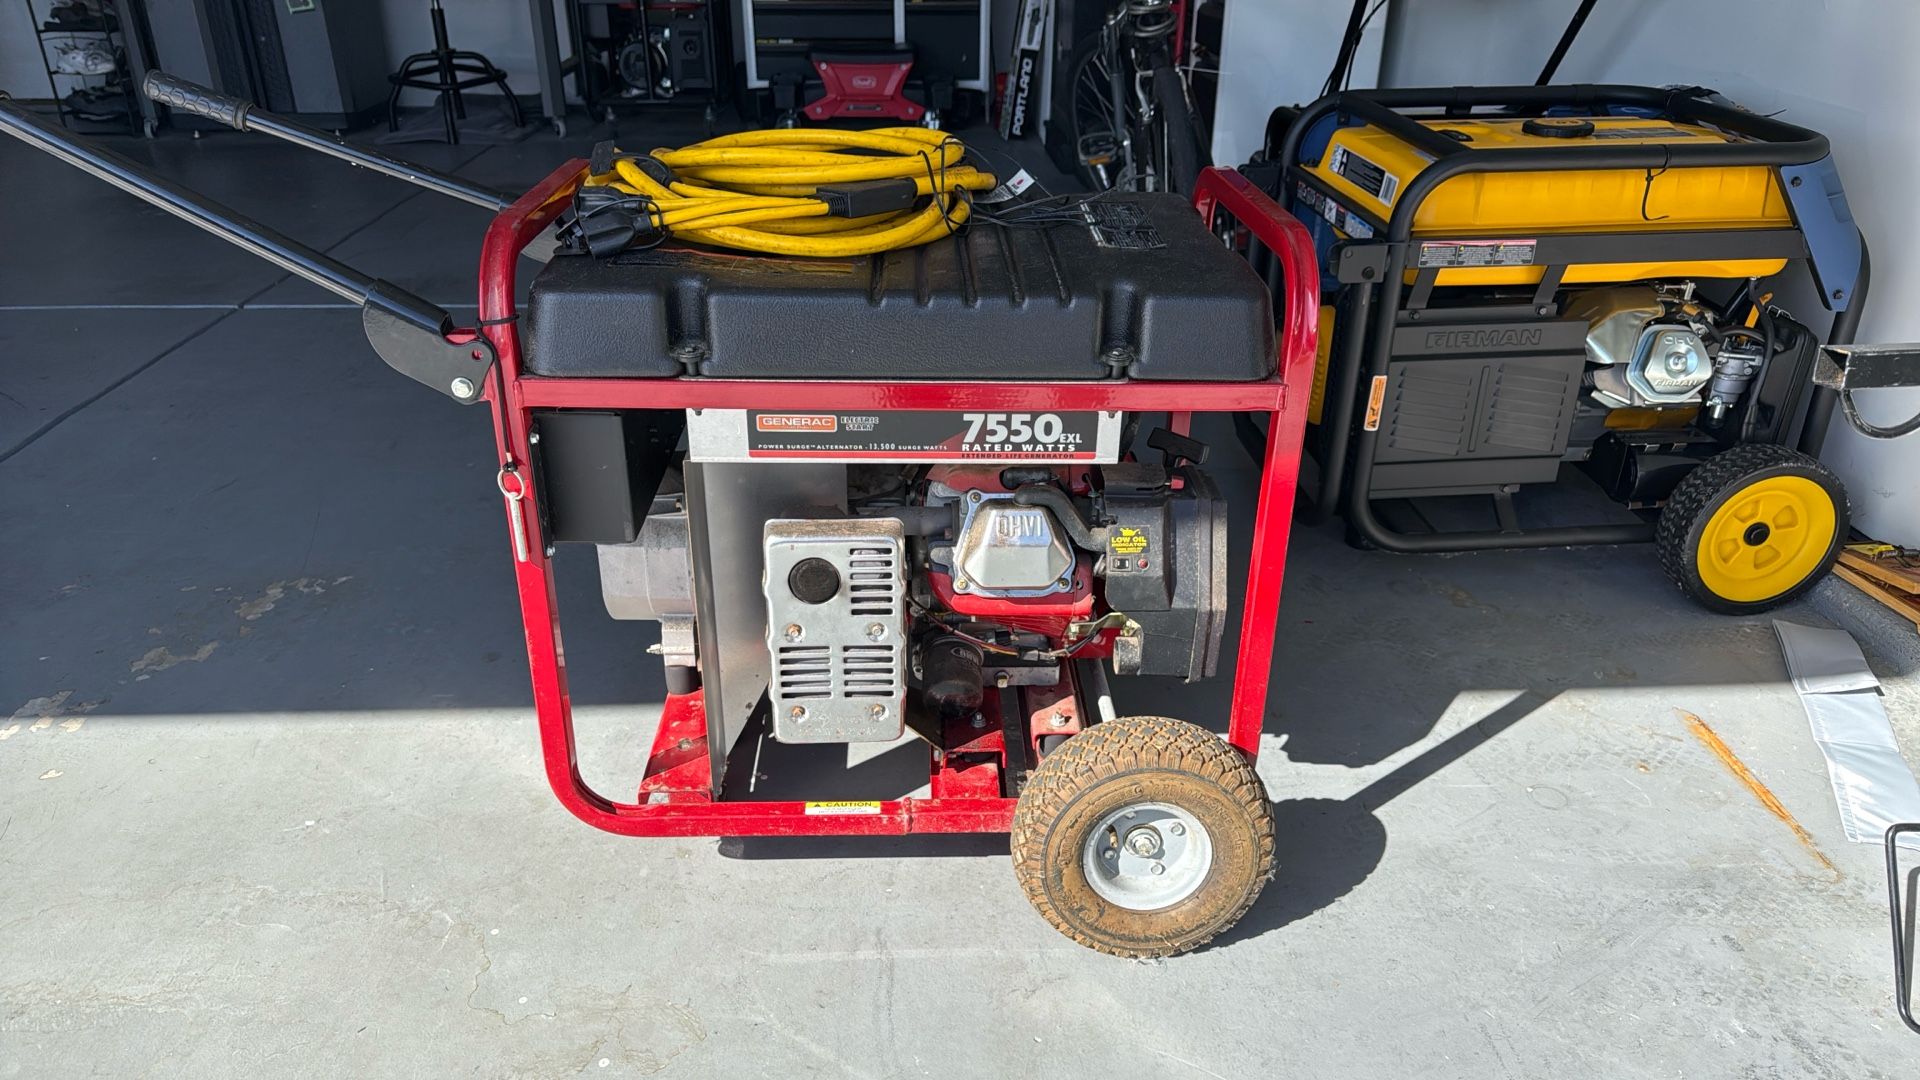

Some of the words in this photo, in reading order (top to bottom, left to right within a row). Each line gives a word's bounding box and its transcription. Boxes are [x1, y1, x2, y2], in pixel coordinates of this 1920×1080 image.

[1013, 58, 1032, 135] PORTLAND
[1425, 329, 1542, 348] FIRMAN
[762, 417, 832, 426] GENERAC
[841, 416, 879, 424] ELECTRIC
[963, 413, 1063, 443] 7550
[1059, 433, 1082, 443] EXL
[961, 443, 1013, 452] RATED
[1021, 443, 1076, 452] WATTS
[1132, 535, 1147, 543] OIL
